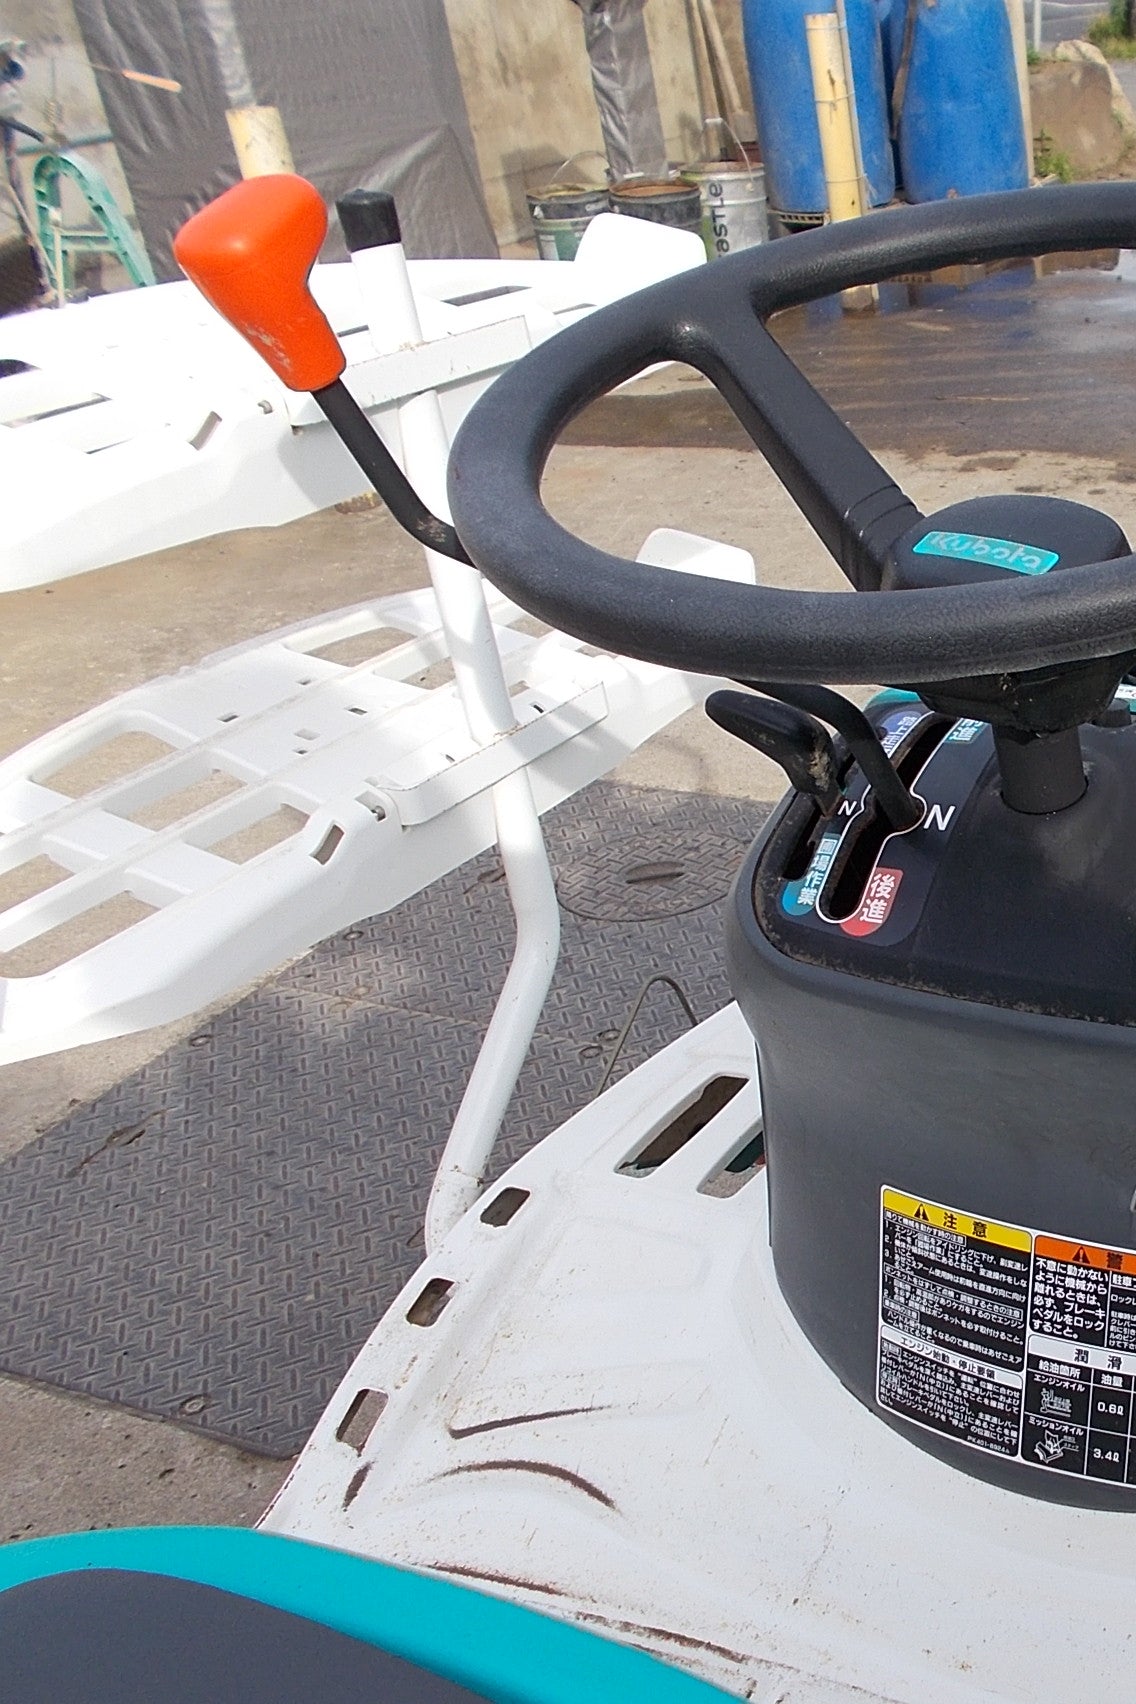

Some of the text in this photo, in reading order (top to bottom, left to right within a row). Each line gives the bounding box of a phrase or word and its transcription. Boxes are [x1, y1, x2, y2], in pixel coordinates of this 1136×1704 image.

[930, 534, 1041, 569] Kubota
[838, 800, 857, 816] N
[923, 805, 955, 830] N
[859, 873, 895, 924] 後進
[943, 1212, 988, 1237] 注意
[1035, 1257, 1109, 1282] 不意に動かない
[1034, 1282, 1103, 1307] 離れるときは、
[1035, 1271, 1107, 1295] ように機械から
[1032, 1308, 1105, 1331] ペダルをロック
[1033, 1297, 1106, 1319] 必ず、ブレーキ
[1032, 1319, 1079, 1340] すること。
[900, 1336, 995, 1380] エンジン始動・停止要領
[1038, 1360, 1081, 1379] 給油箇所
[1033, 1374, 1086, 1392] エンジンオイル
[1101, 1374, 1123, 1387] 油量
[1028, 1417, 1084, 1436] ミッションオイル
